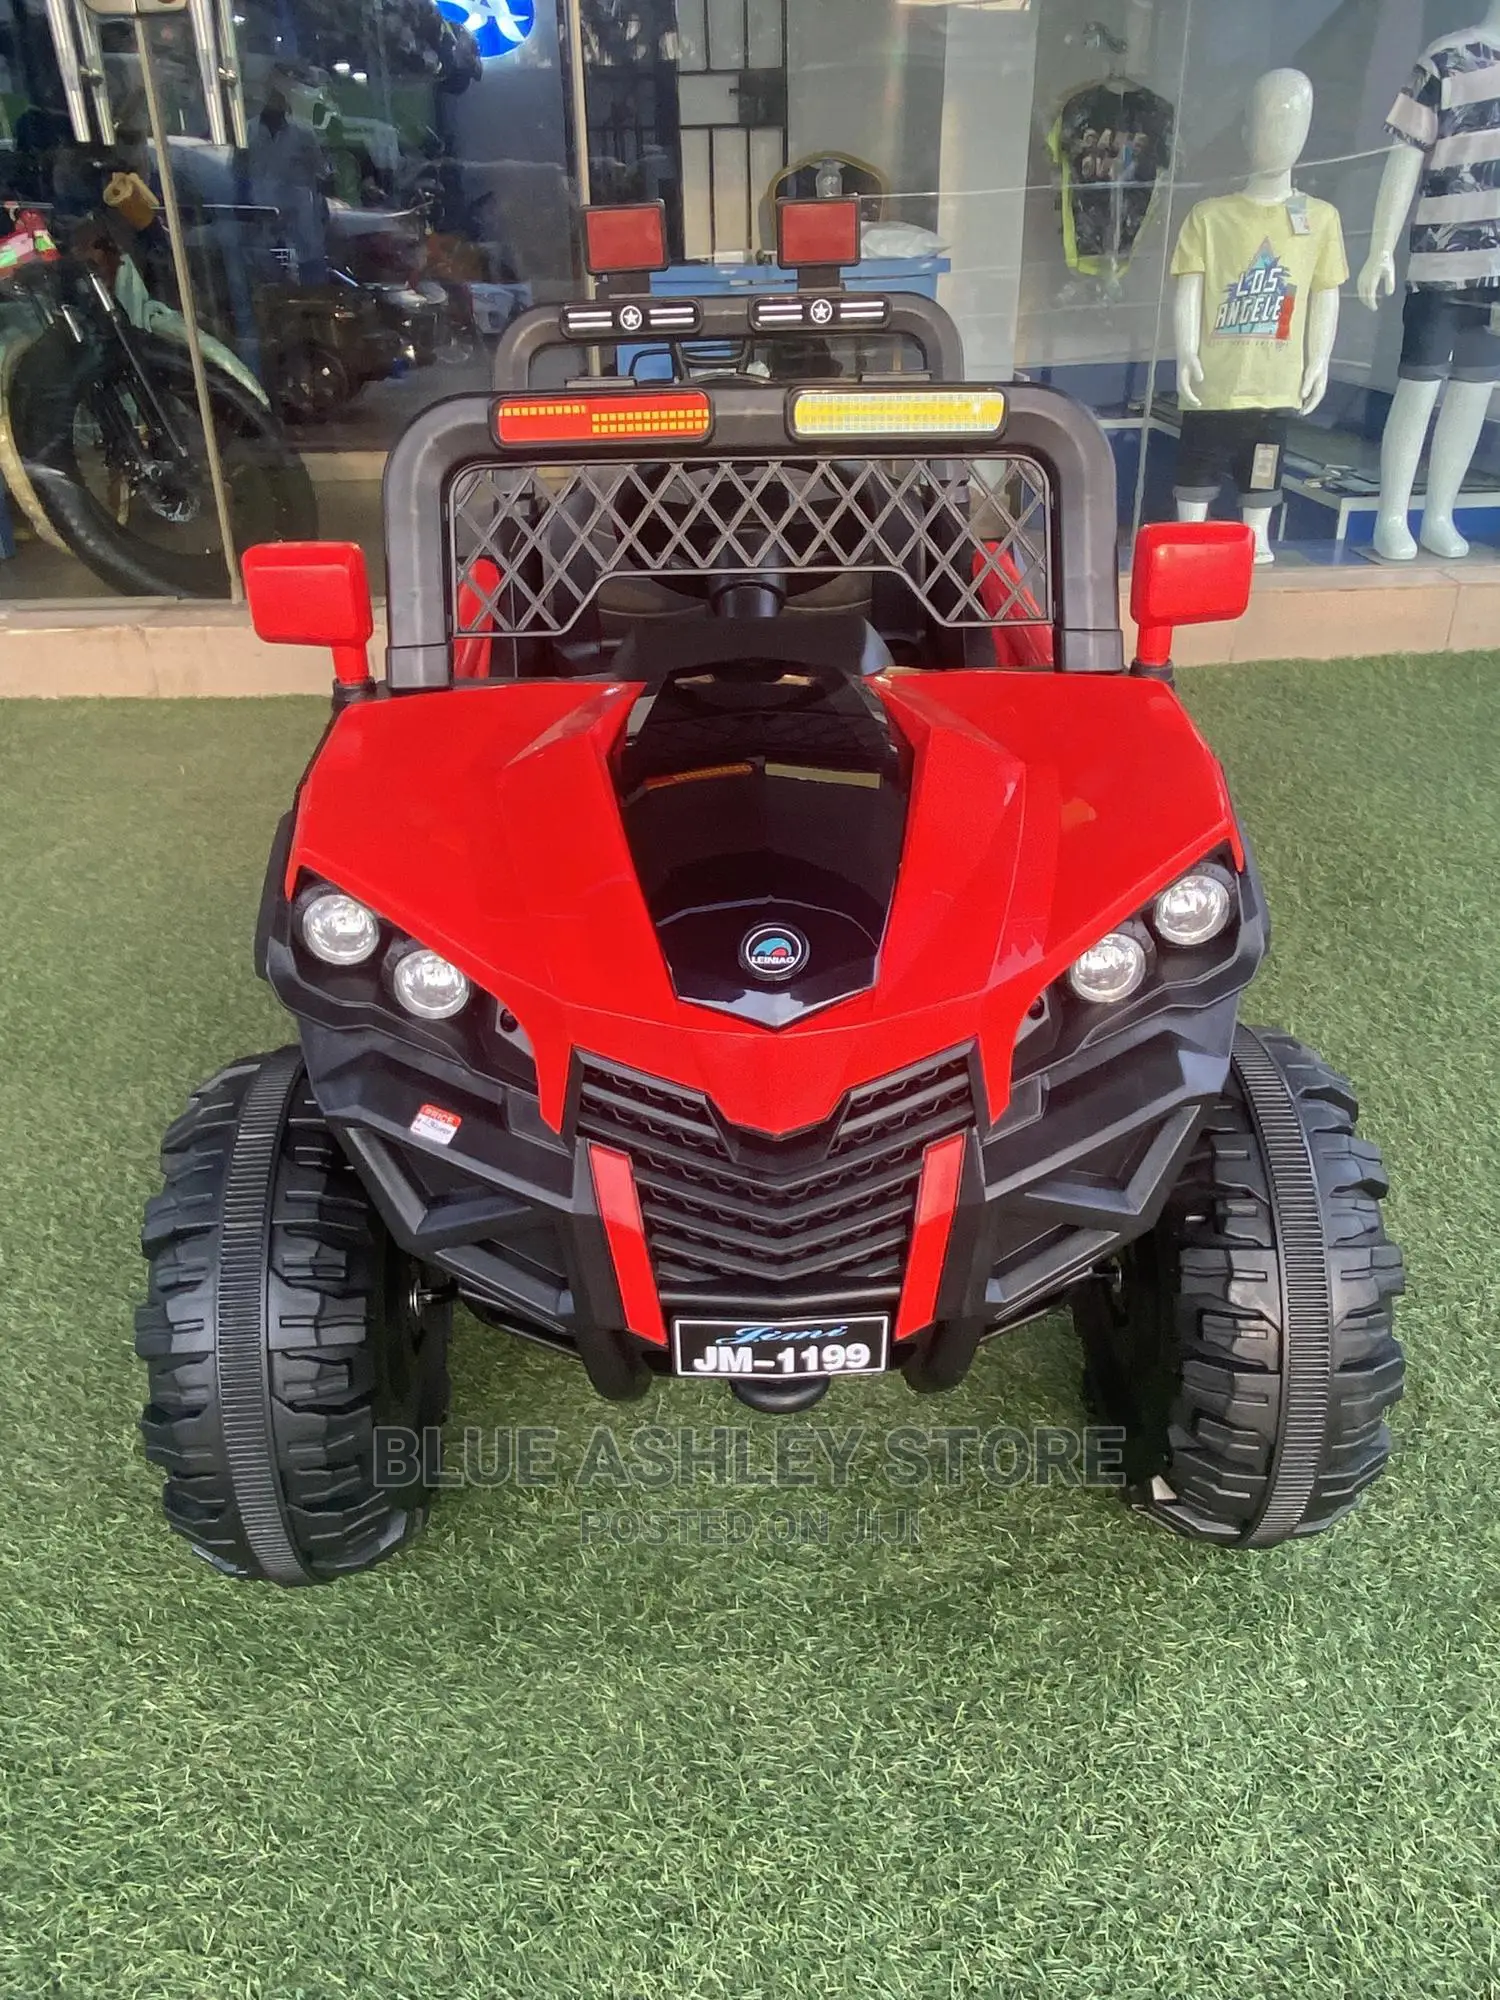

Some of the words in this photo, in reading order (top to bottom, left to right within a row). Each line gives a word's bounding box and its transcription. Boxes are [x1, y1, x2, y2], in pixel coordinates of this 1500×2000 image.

[1236, 267, 1282, 297] LOS
[1215, 295, 1285, 329] ANGELE
[751, 956, 795, 964] LEINIAO
[423, 1107, 455, 1126] PRICE
[693, 1342, 871, 1373] JM-1199
